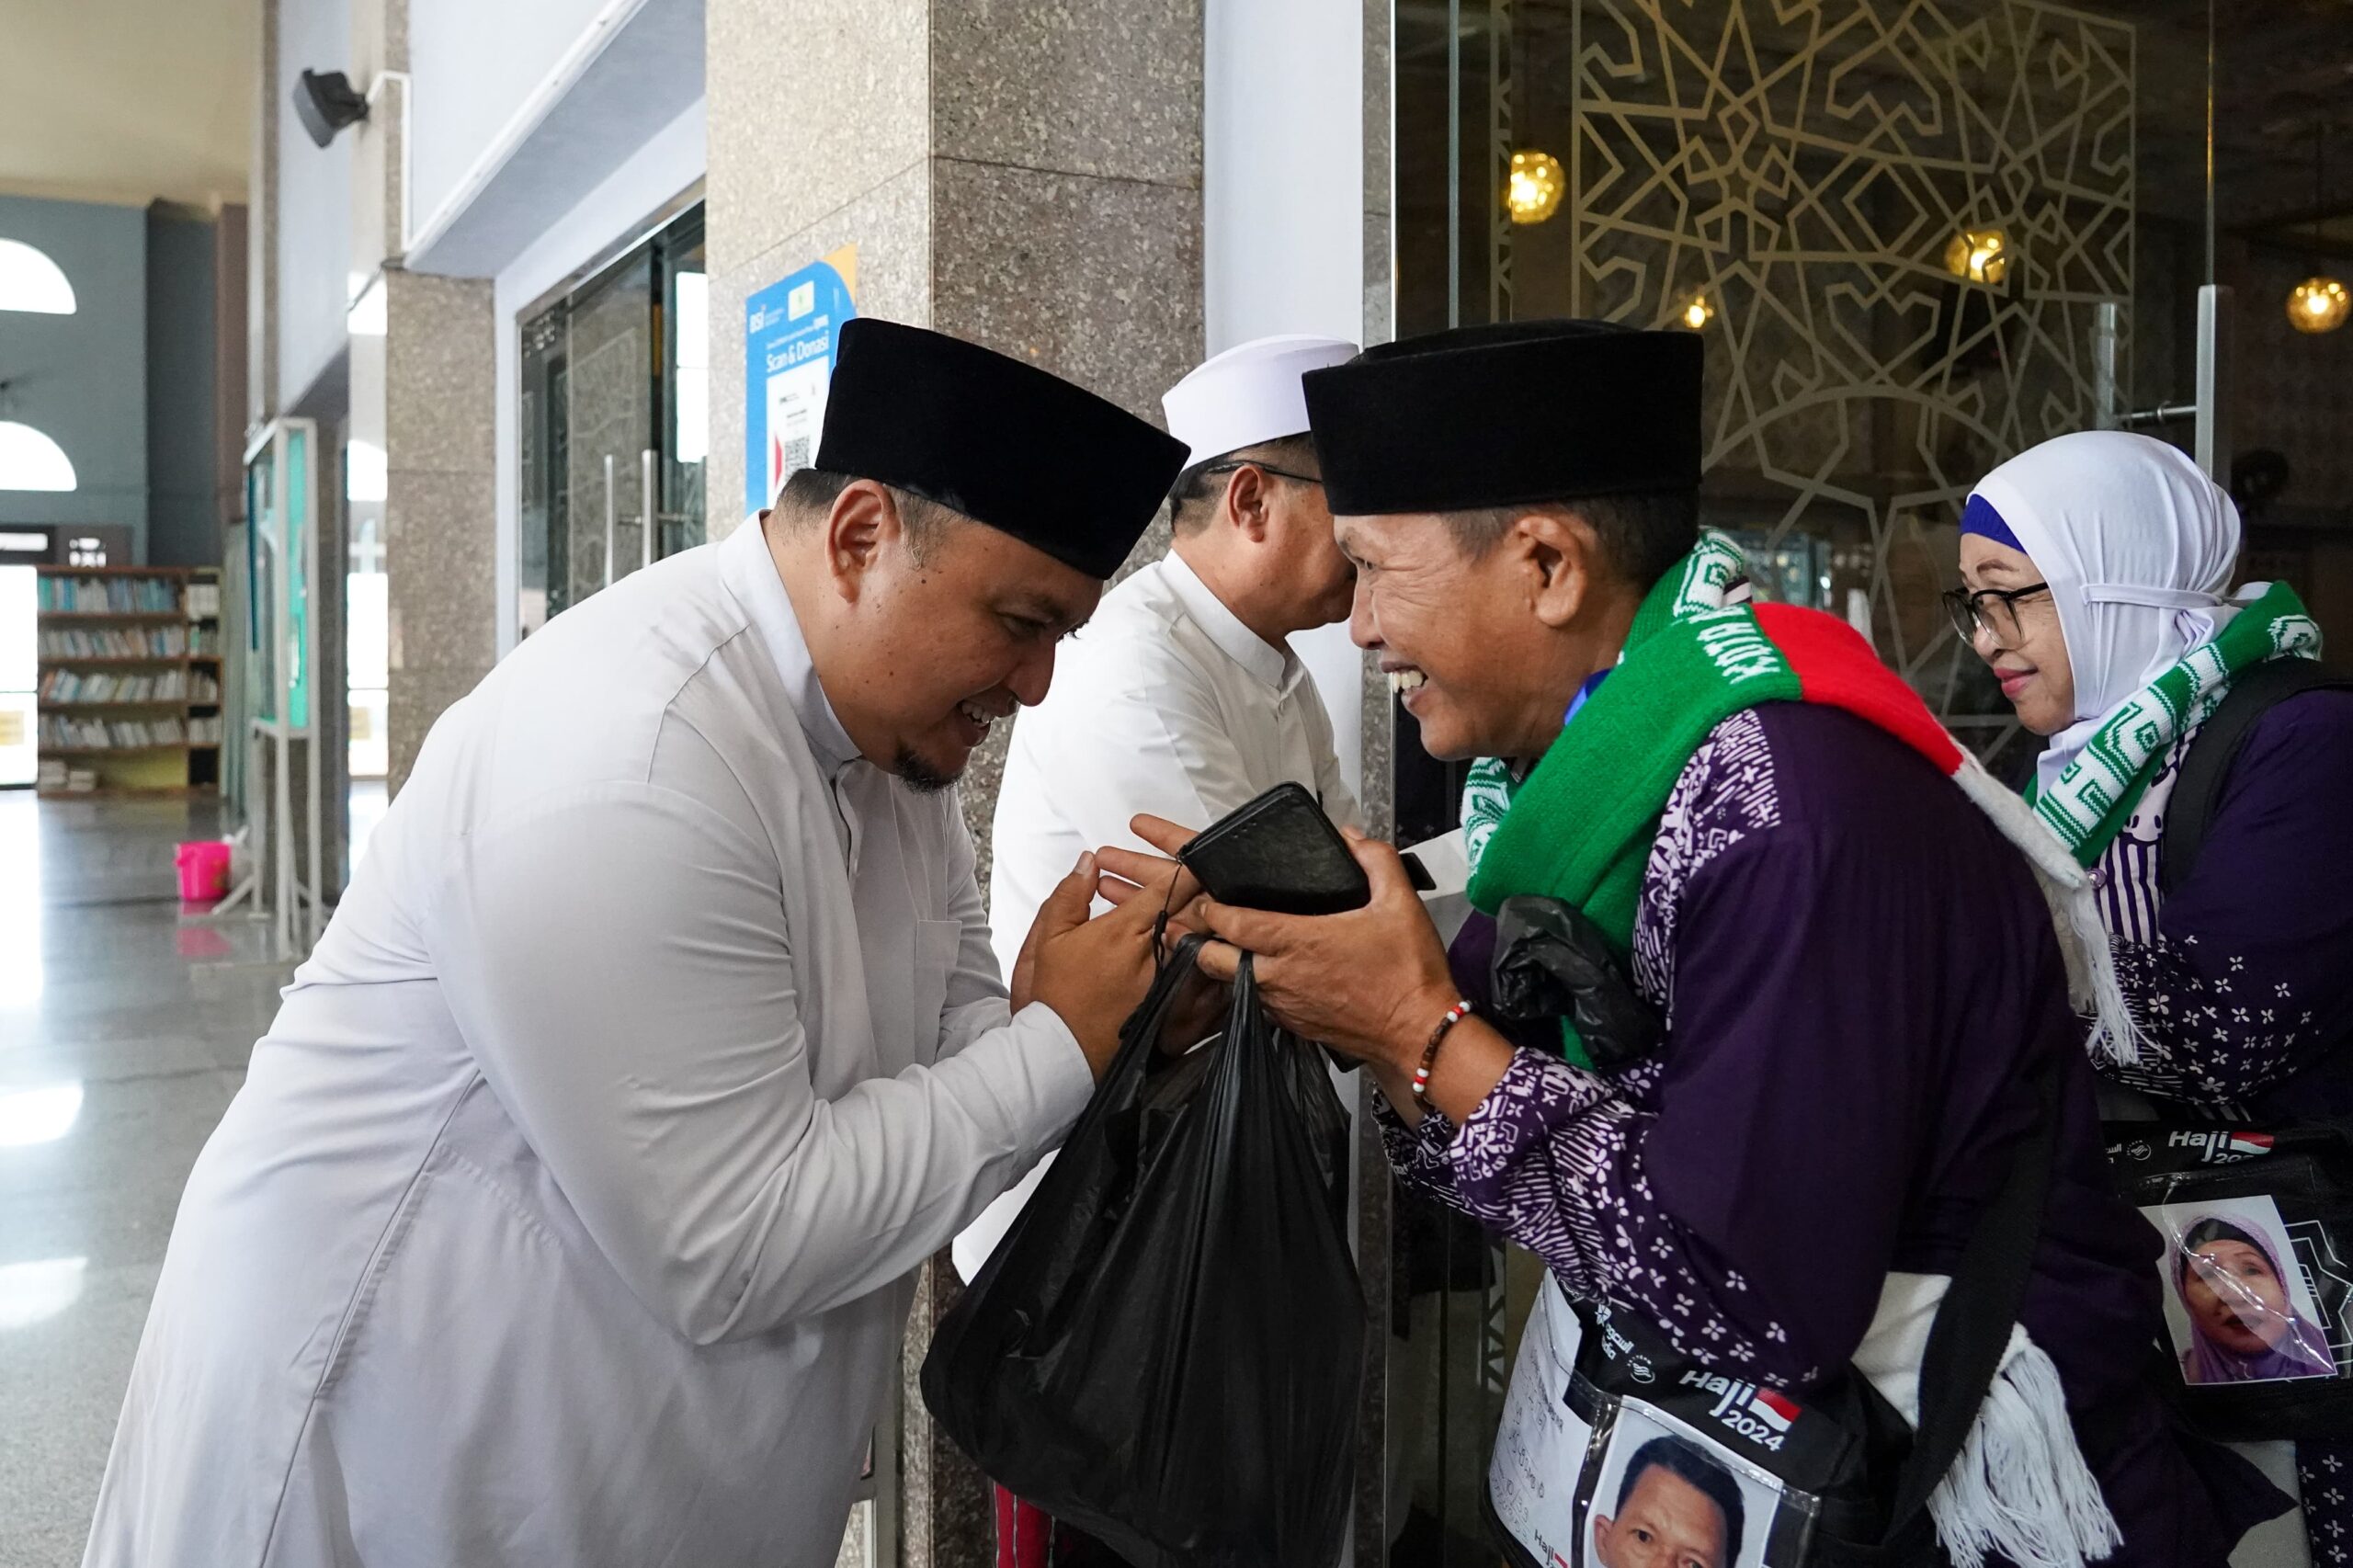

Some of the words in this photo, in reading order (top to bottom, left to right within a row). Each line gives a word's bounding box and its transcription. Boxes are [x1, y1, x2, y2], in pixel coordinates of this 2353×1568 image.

[767, 353, 788, 373] Scan
[789, 345, 796, 366] &
[796, 329, 829, 361] Donasi
[1697, 621, 1780, 685] KOTA
[2168, 1131, 2228, 1163] Haji
[1679, 1370, 1756, 1417] Haji
[1722, 1410, 1786, 1451] 2024
[1534, 1528, 1554, 1566] Haji
